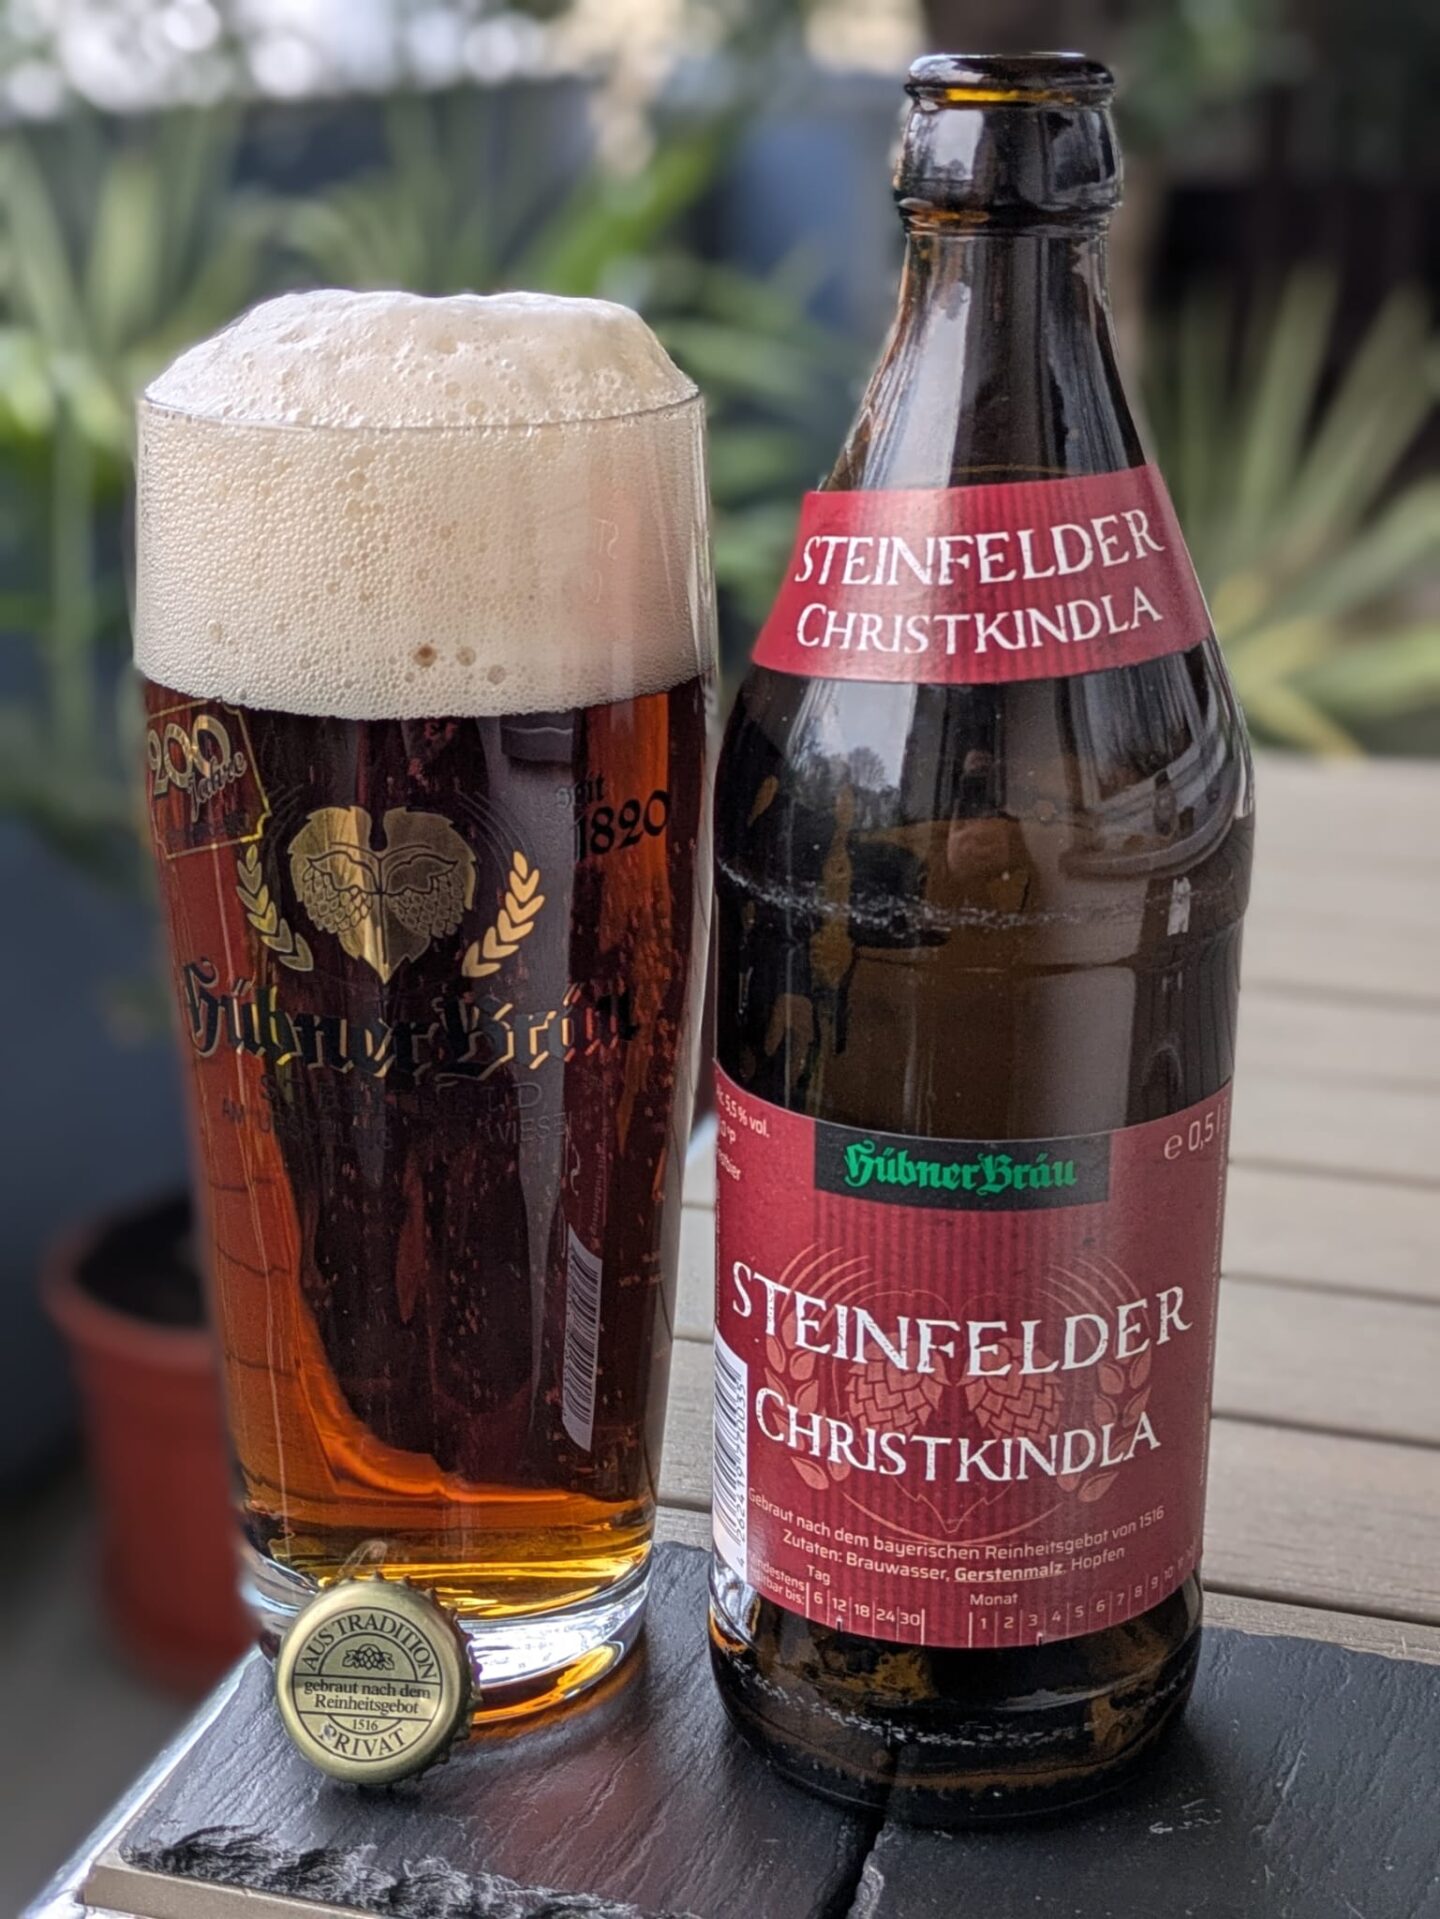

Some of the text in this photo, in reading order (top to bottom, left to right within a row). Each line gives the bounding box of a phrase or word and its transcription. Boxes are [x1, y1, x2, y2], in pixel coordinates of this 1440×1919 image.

[795, 508, 1164, 587] STEINFELDER
[796, 586, 1163, 655] CHRISTKINDLA
[148, 714, 231, 796] 200
[573, 790, 672, 862] 1820
[749, 1116, 770, 1138] vol.
[1188, 1111, 1214, 1151] 0,5
[732, 1260, 1193, 1378] STEINFELDER
[755, 1387, 1162, 1483] CHRISTKINDLA
[749, 1488, 1165, 1560] Gebraut nach dem bayerischen Reinheitsgebot von 1516
[782, 1528, 842, 1563] Zutaten:
[846, 1551, 950, 1582] Brauwasser,
[1071, 1547, 1126, 1571] Hopfen
[807, 1564, 831, 1586] Tag
[813, 1591, 921, 1627] 6 12 18 24 30
[970, 1593, 1019, 1607] Monat
[980, 1617, 987, 1630] 1
[1003, 1616, 1014, 1629] 2
[1028, 1614, 1038, 1627] 3
[1051, 1610, 1061, 1623] 4
[1074, 1605, 1084, 1618] 5
[1096, 1599, 1106, 1613] 6
[1116, 1593, 1125, 1606] 7
[1134, 1585, 1143, 1599] 8
[1151, 1576, 1159, 1590] 9
[1164, 1566, 1174, 1581] 10
[301, 1613, 437, 1680] AUS TRADITION
[303, 1678, 431, 1700] gebraut nach dem
[314, 1693, 420, 1716] Reinheitsgebot
[318, 1723, 407, 1758] PRIVAT
[352, 1718, 379, 1732] 1516
